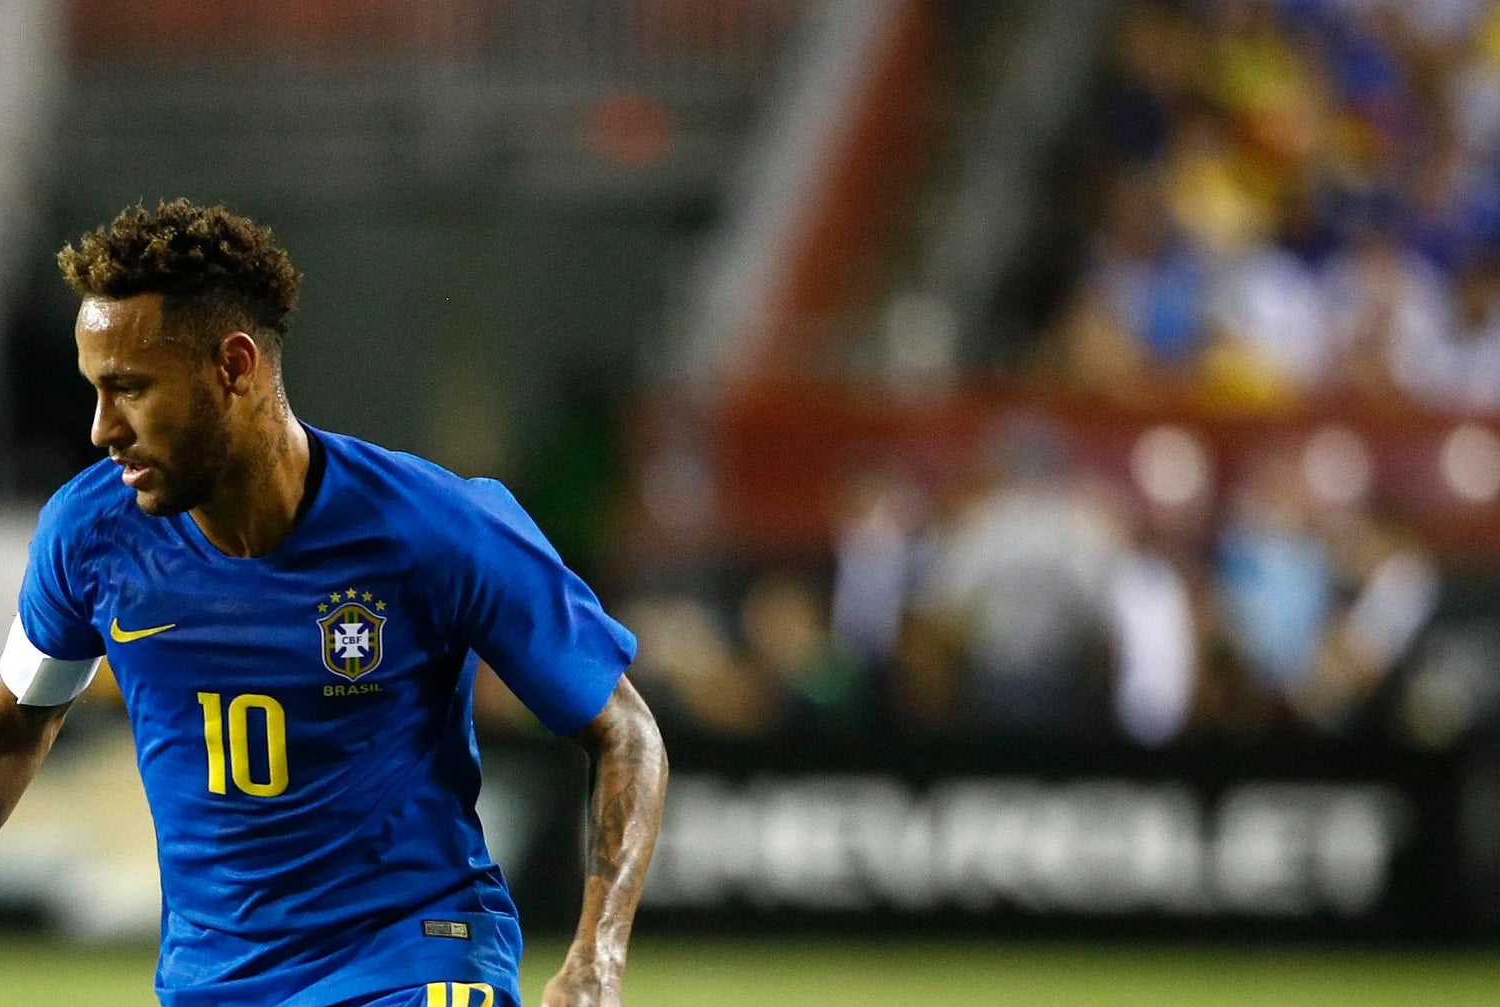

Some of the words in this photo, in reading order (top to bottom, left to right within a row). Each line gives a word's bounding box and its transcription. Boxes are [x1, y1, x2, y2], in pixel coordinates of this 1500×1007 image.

[341, 636, 362, 645] CBF
[323, 683, 383, 696] BRASIL
[197, 691, 289, 798] 10
[650, 778, 1398, 912] HEVROLET
